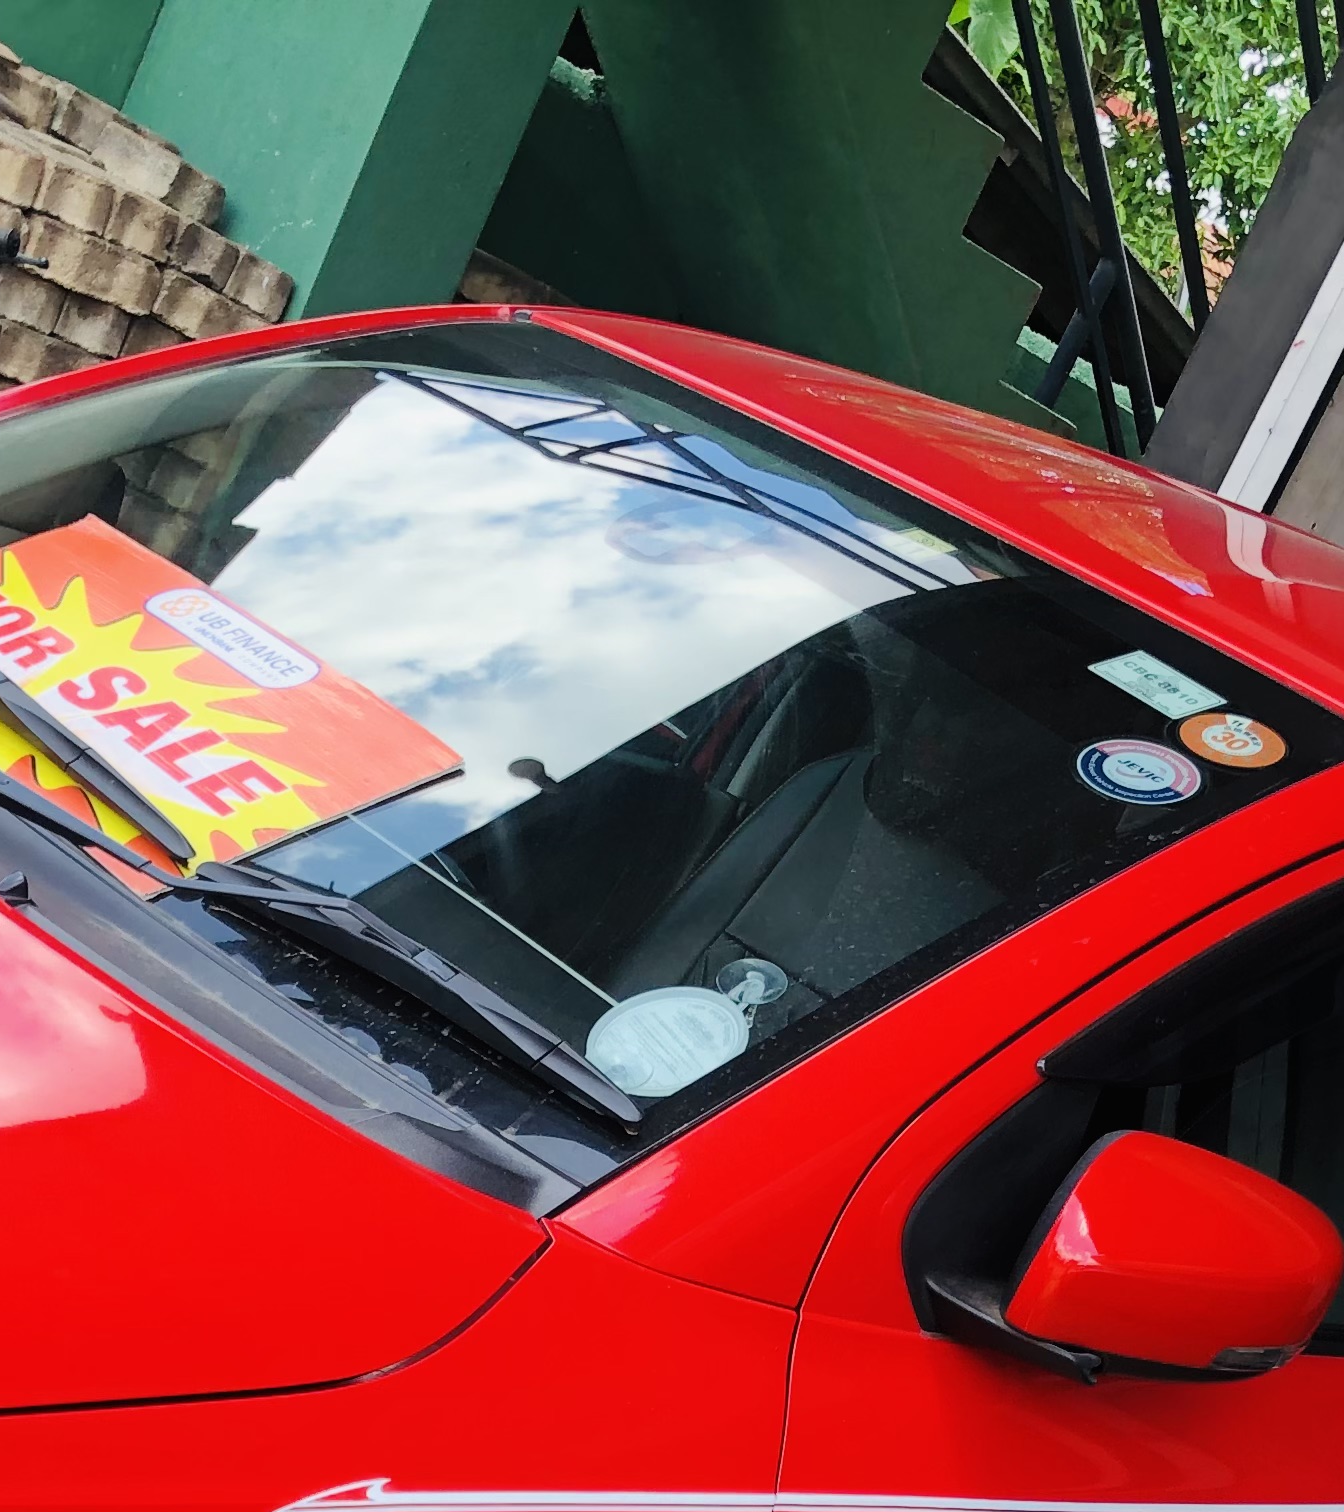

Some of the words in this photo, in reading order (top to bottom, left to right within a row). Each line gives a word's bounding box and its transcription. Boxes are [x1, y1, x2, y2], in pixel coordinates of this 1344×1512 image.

[198, 611, 232, 630] UB
[223, 627, 304, 677] FINANCE
[57, 666, 289, 817] SALE
[1211, 731, 1250, 751] 30
[1117, 759, 1164, 784] JEVIC
